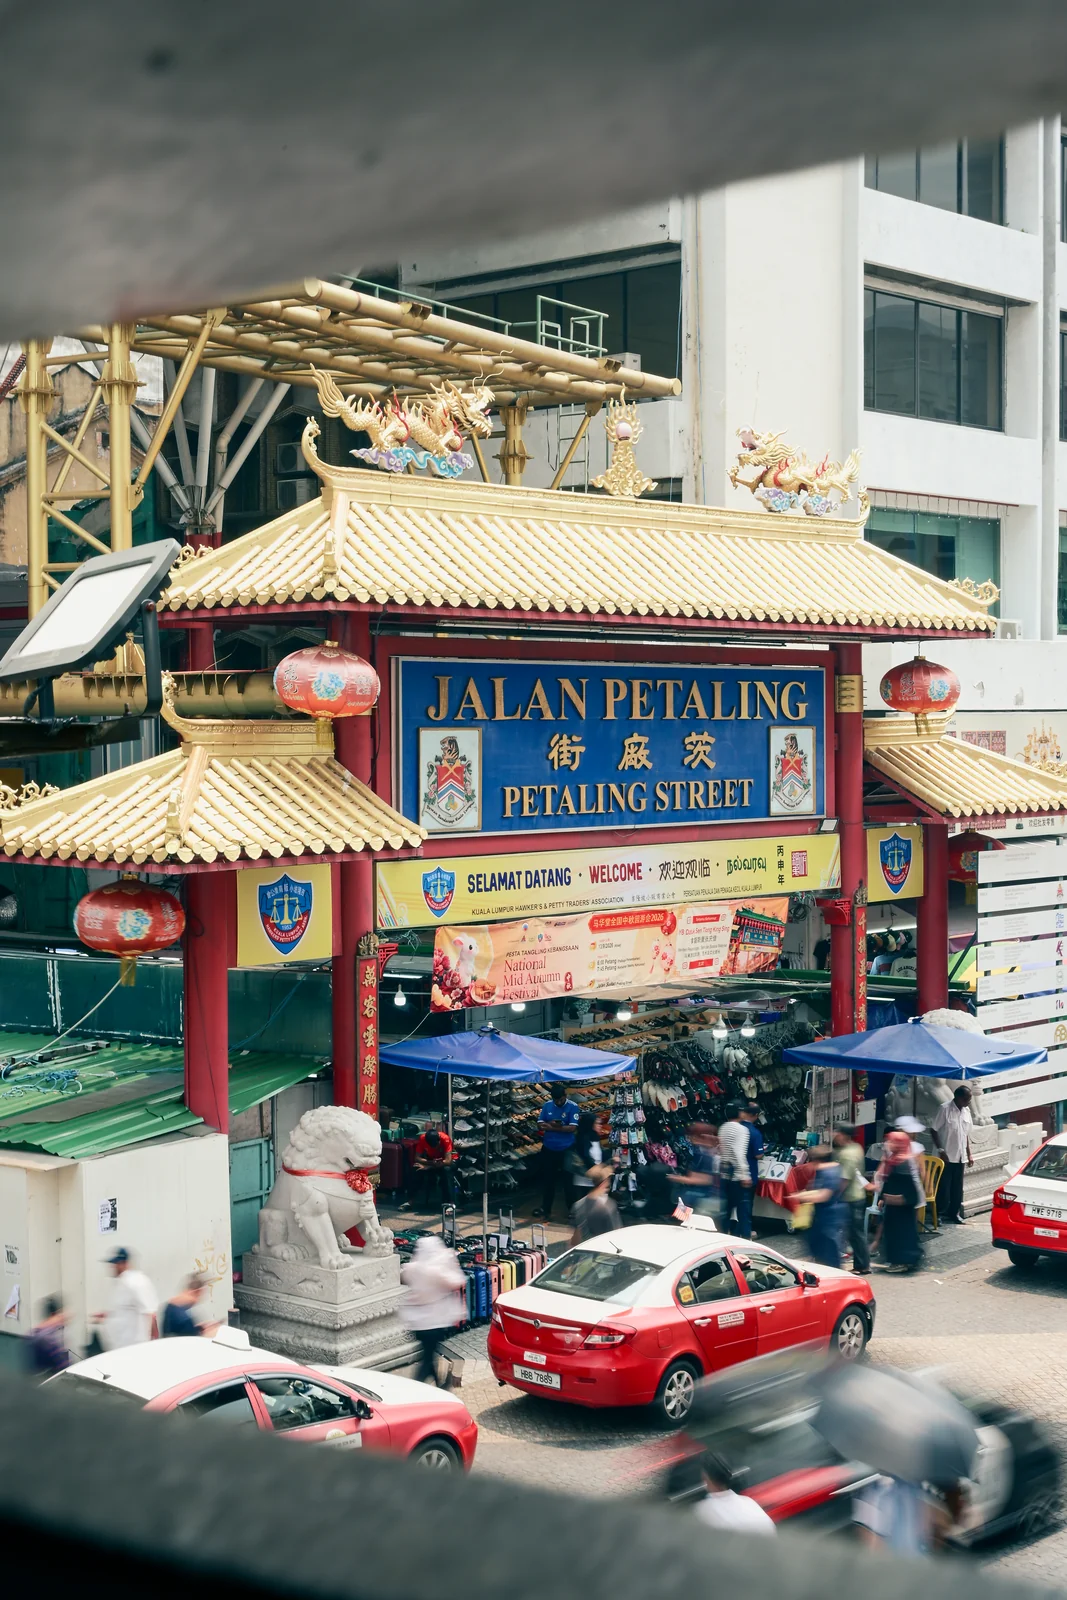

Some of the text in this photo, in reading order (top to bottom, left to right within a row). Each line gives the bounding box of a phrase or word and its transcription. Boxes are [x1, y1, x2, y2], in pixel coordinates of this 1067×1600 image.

[427, 676, 808, 721] JALAN PETALING
[503, 778, 754, 818] PETALING STREET
[776, 845, 785, 886] 丙申年
[468, 870, 522, 894] SELAMAT
[525, 867, 572, 890] DATANG
[588, 862, 643, 886] WELCOME
[492, 906, 514, 914] LUMPUR
[548, 901, 565, 909] PETTY
[591, 896, 624, 905] ASSOCIATION
[548, 944, 579, 953] KEBANGSAAN
[504, 956, 546, 972] National
[503, 972, 561, 987] Mid Autumn
[502, 986, 539, 1000] Festival
[1032, 1207, 1045, 1216] HWE
